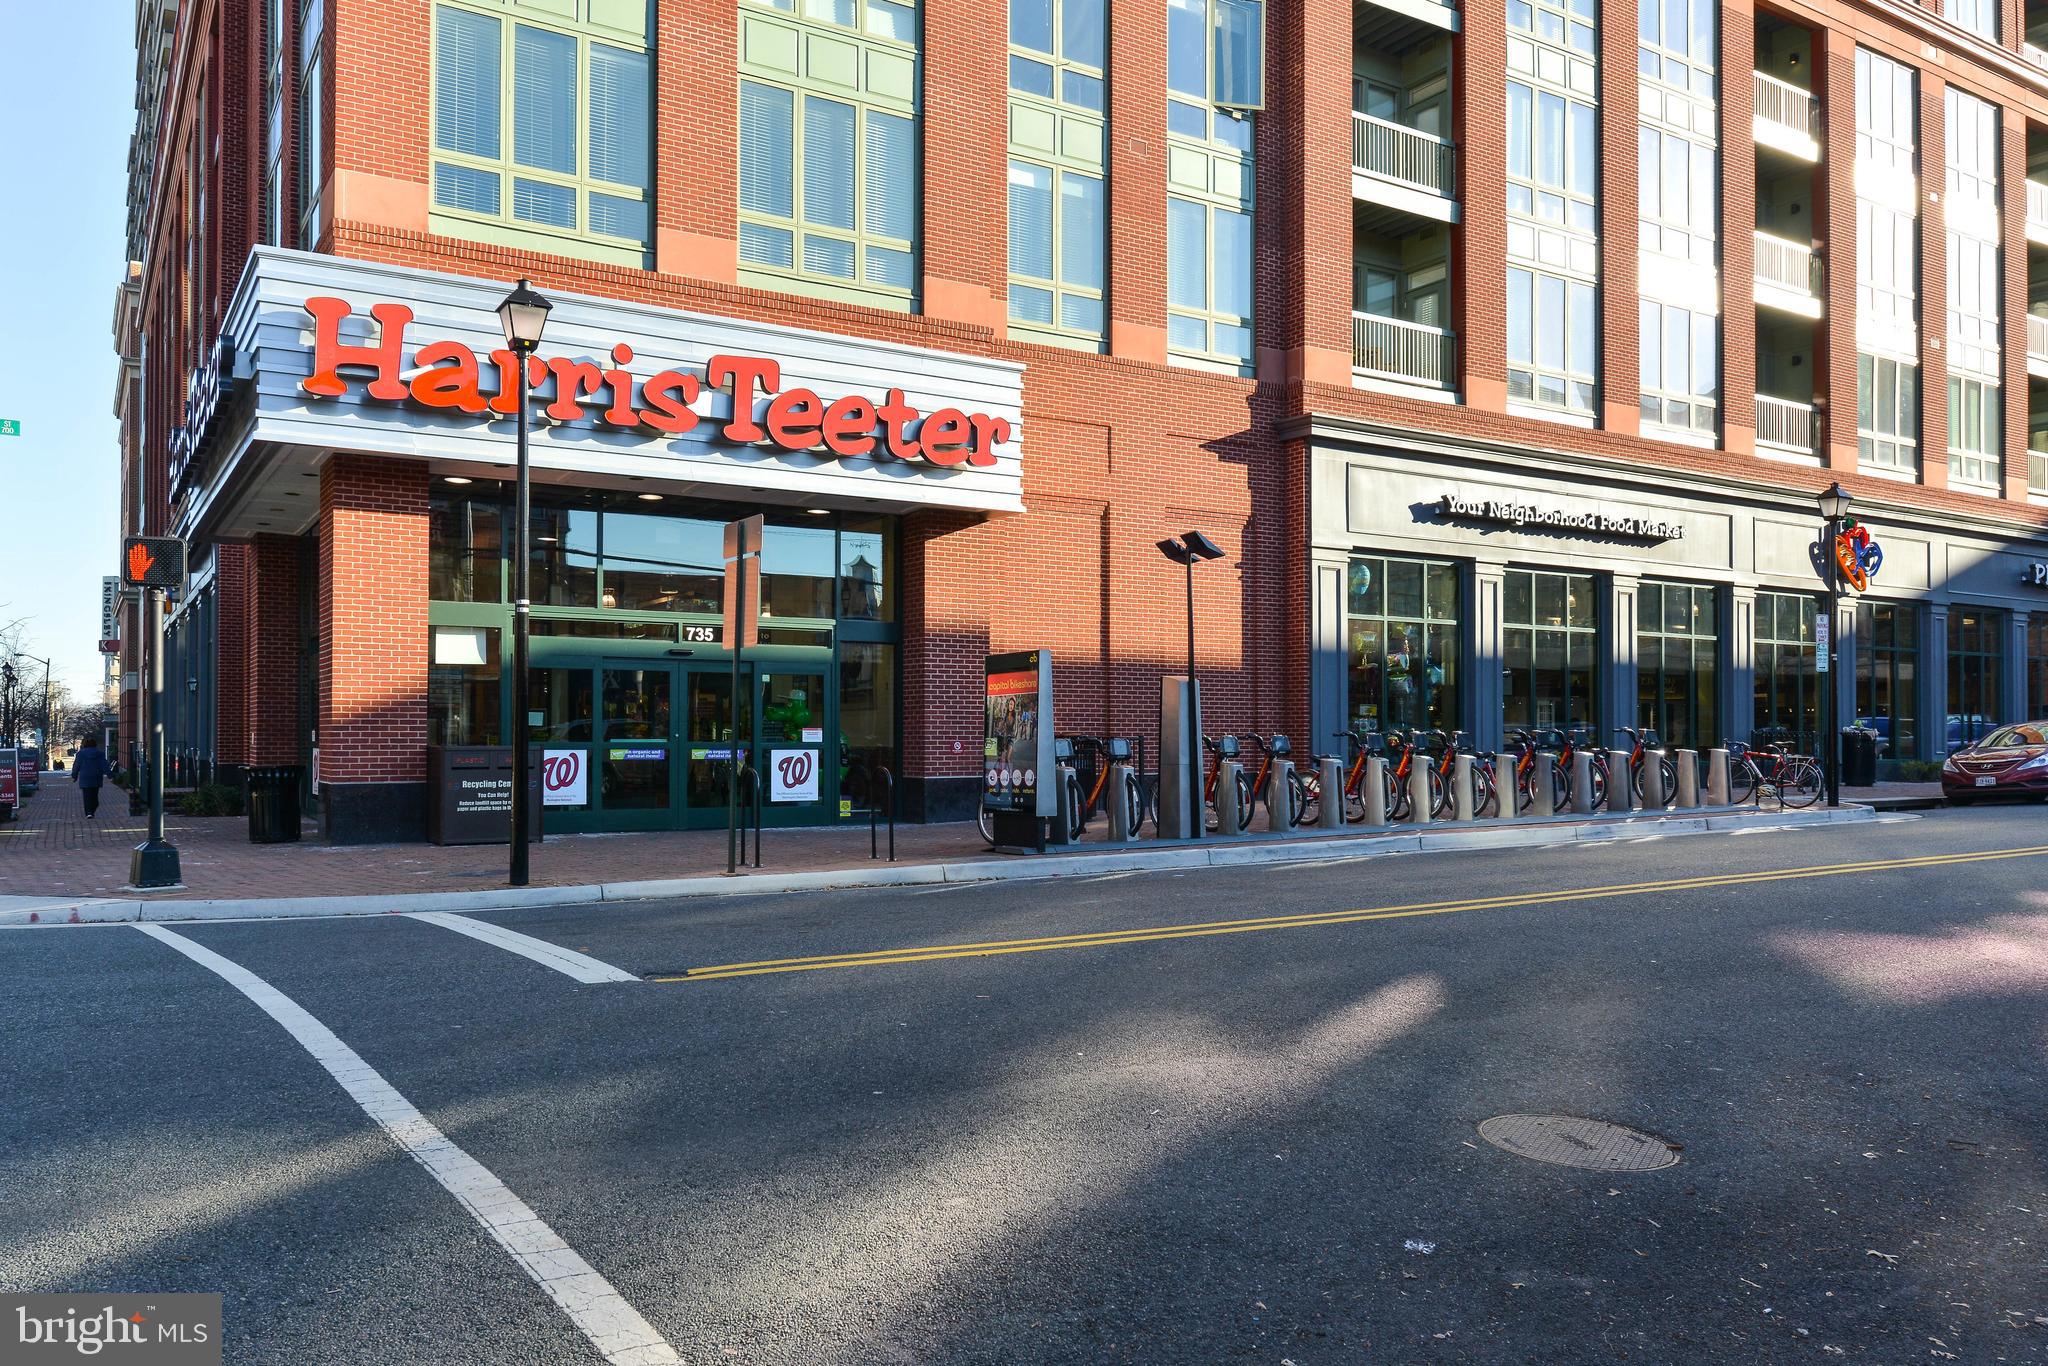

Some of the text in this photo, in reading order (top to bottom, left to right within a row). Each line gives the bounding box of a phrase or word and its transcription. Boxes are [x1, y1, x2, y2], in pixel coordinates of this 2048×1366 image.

[302, 296, 1011, 467] Harris Teeter
[1446, 495, 1686, 540] Your Neighborhood Food Market
[101, 641, 108, 650] K
[686, 627, 714, 642] 735
[462, 780, 512, 789] Recycling Cen
[543, 752, 579, 791] W
[778, 751, 812, 789] W
